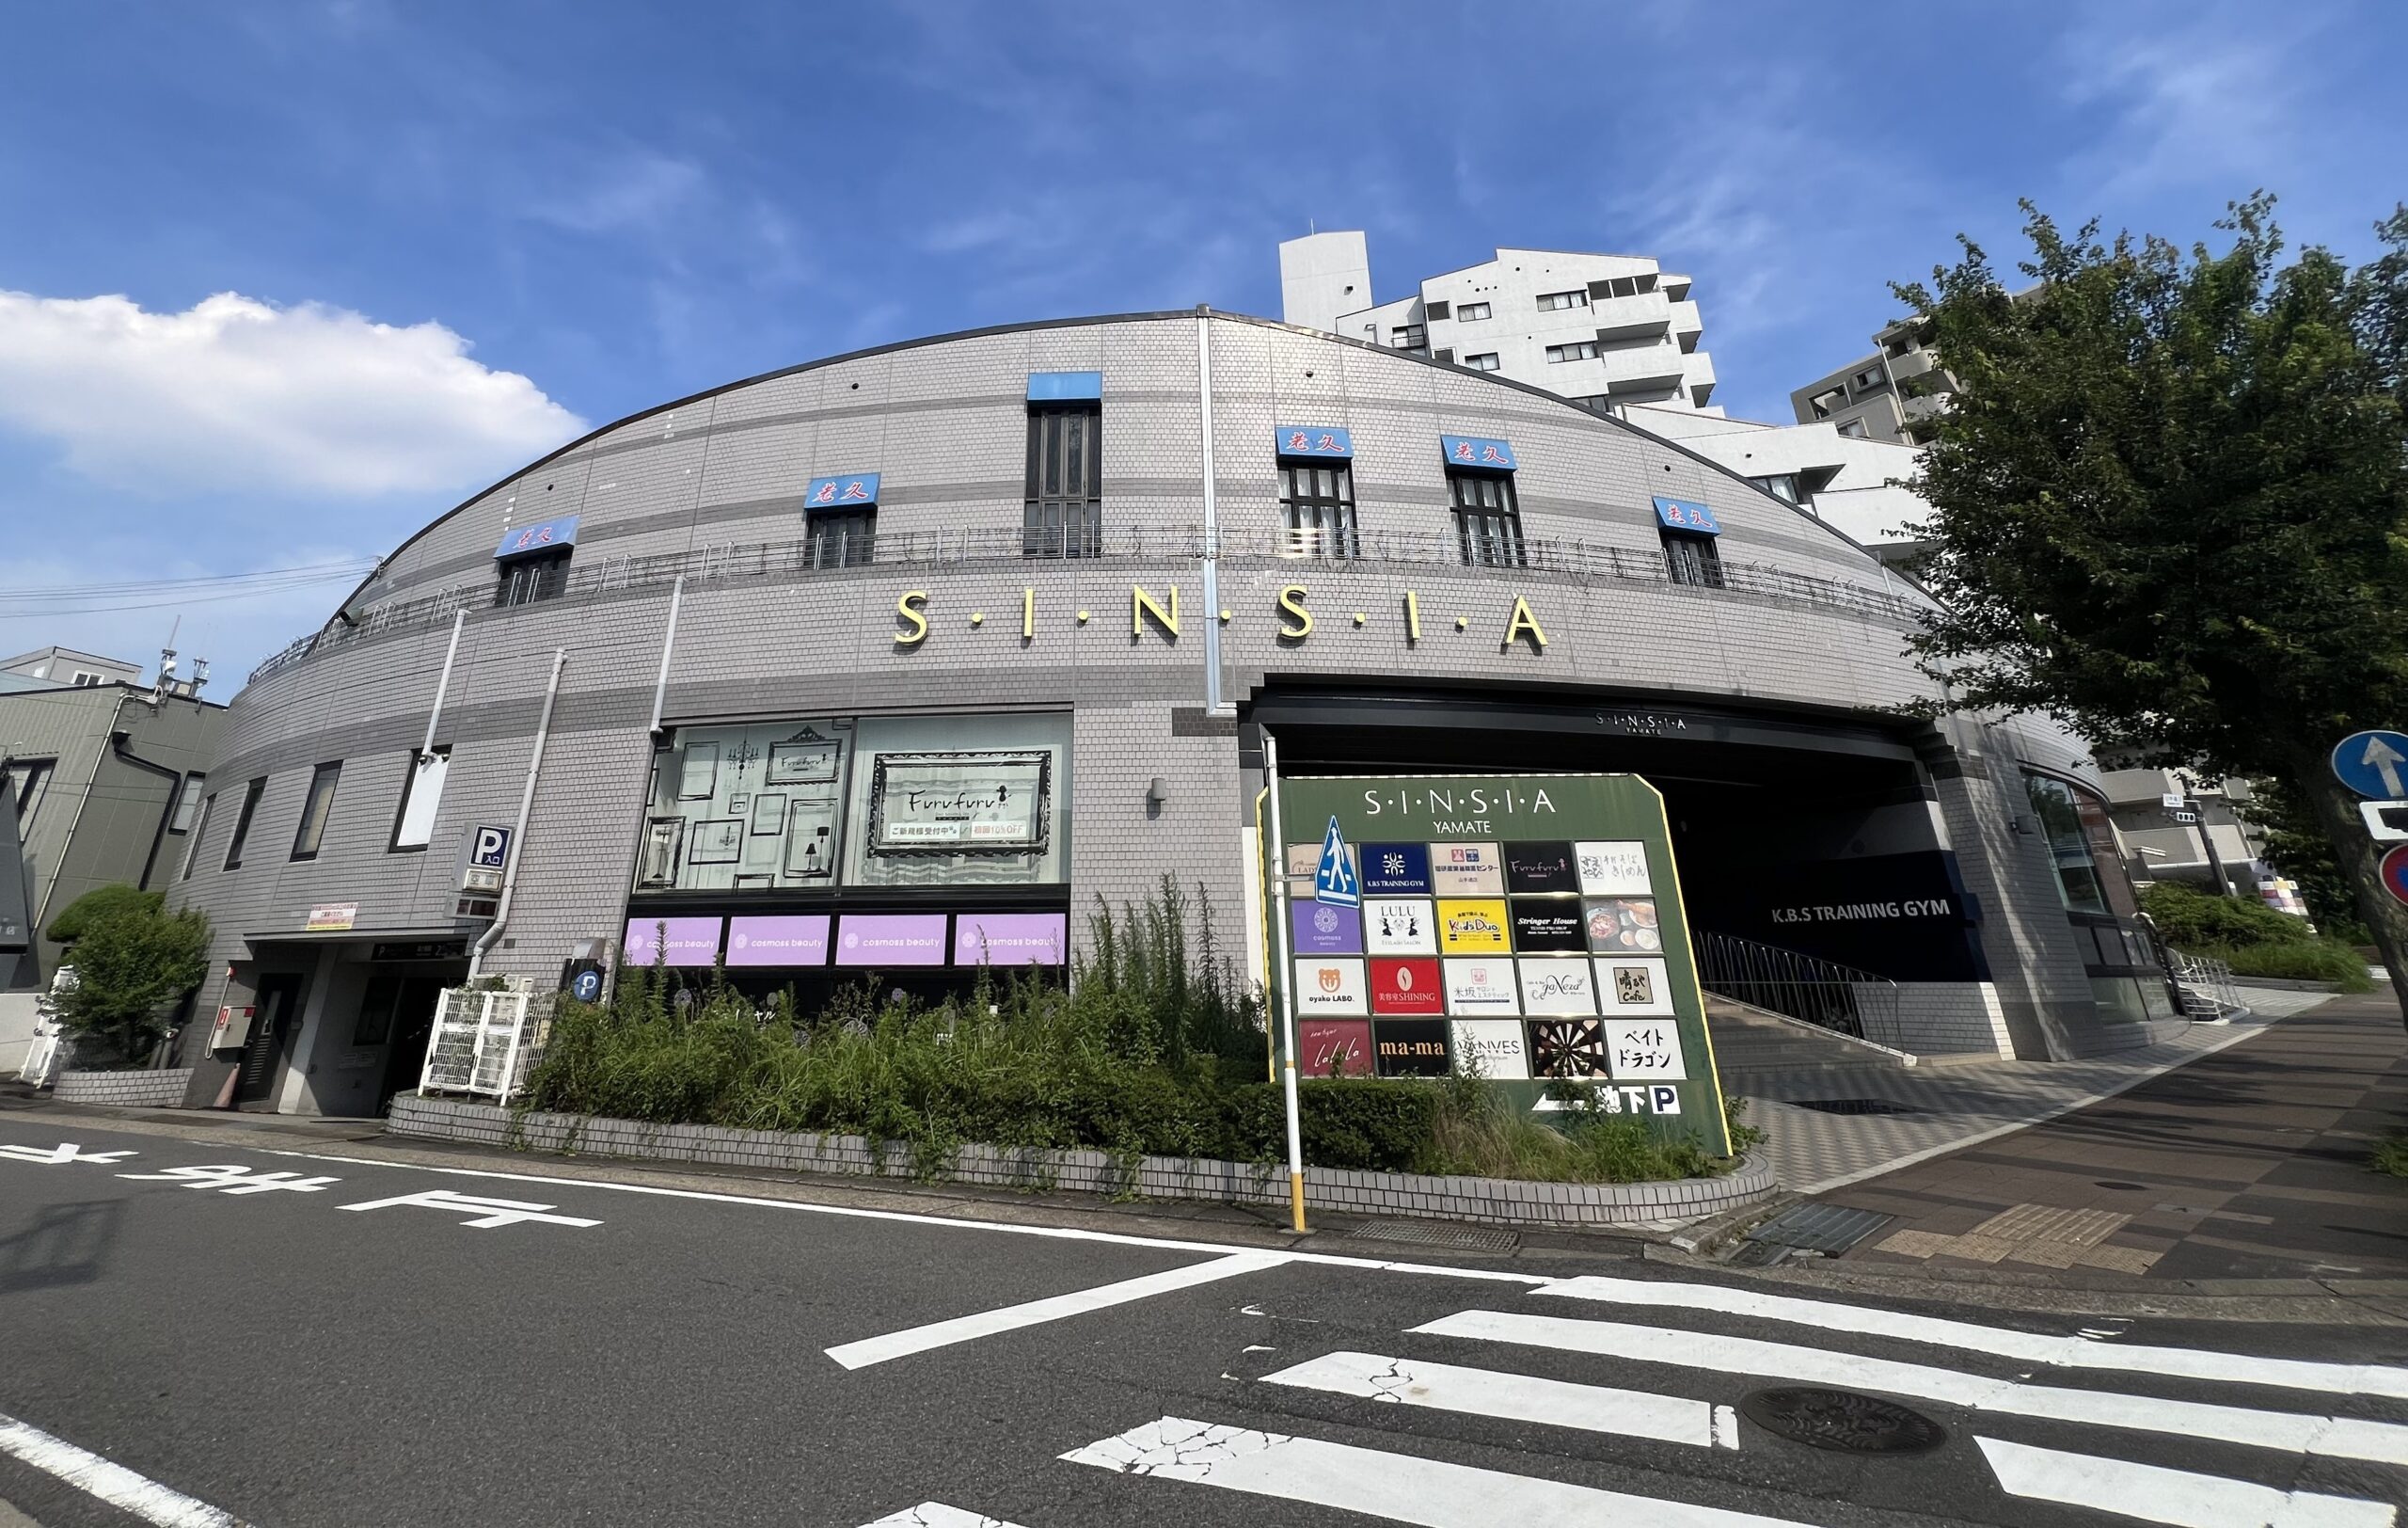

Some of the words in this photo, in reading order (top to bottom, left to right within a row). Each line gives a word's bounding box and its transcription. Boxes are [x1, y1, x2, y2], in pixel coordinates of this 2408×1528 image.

[1433, 820, 1492, 834] YAMATE
[474, 829, 503, 864] P
[484, 855, 500, 865] 入口
[1381, 906, 1416, 916] LULU
[1771, 907, 1812, 923] K.B.S
[1813, 901, 1900, 921] TRAINING
[1903, 899, 1951, 916] GYM
[1517, 917, 1551, 926] Stringer
[685, 939, 715, 948] beauty
[752, 939, 789, 947] cosmoss
[791, 938, 823, 948] beauty
[907, 937, 940, 947] beauty
[1025, 937, 1057, 947] beaut
[580, 976, 596, 995] P
[1308, 995, 1331, 1003] oyako
[1624, 1028, 1663, 1046] ベイト
[1380, 1042, 1445, 1056] ma-ma
[1619, 1049, 1671, 1068] ドラゴン
